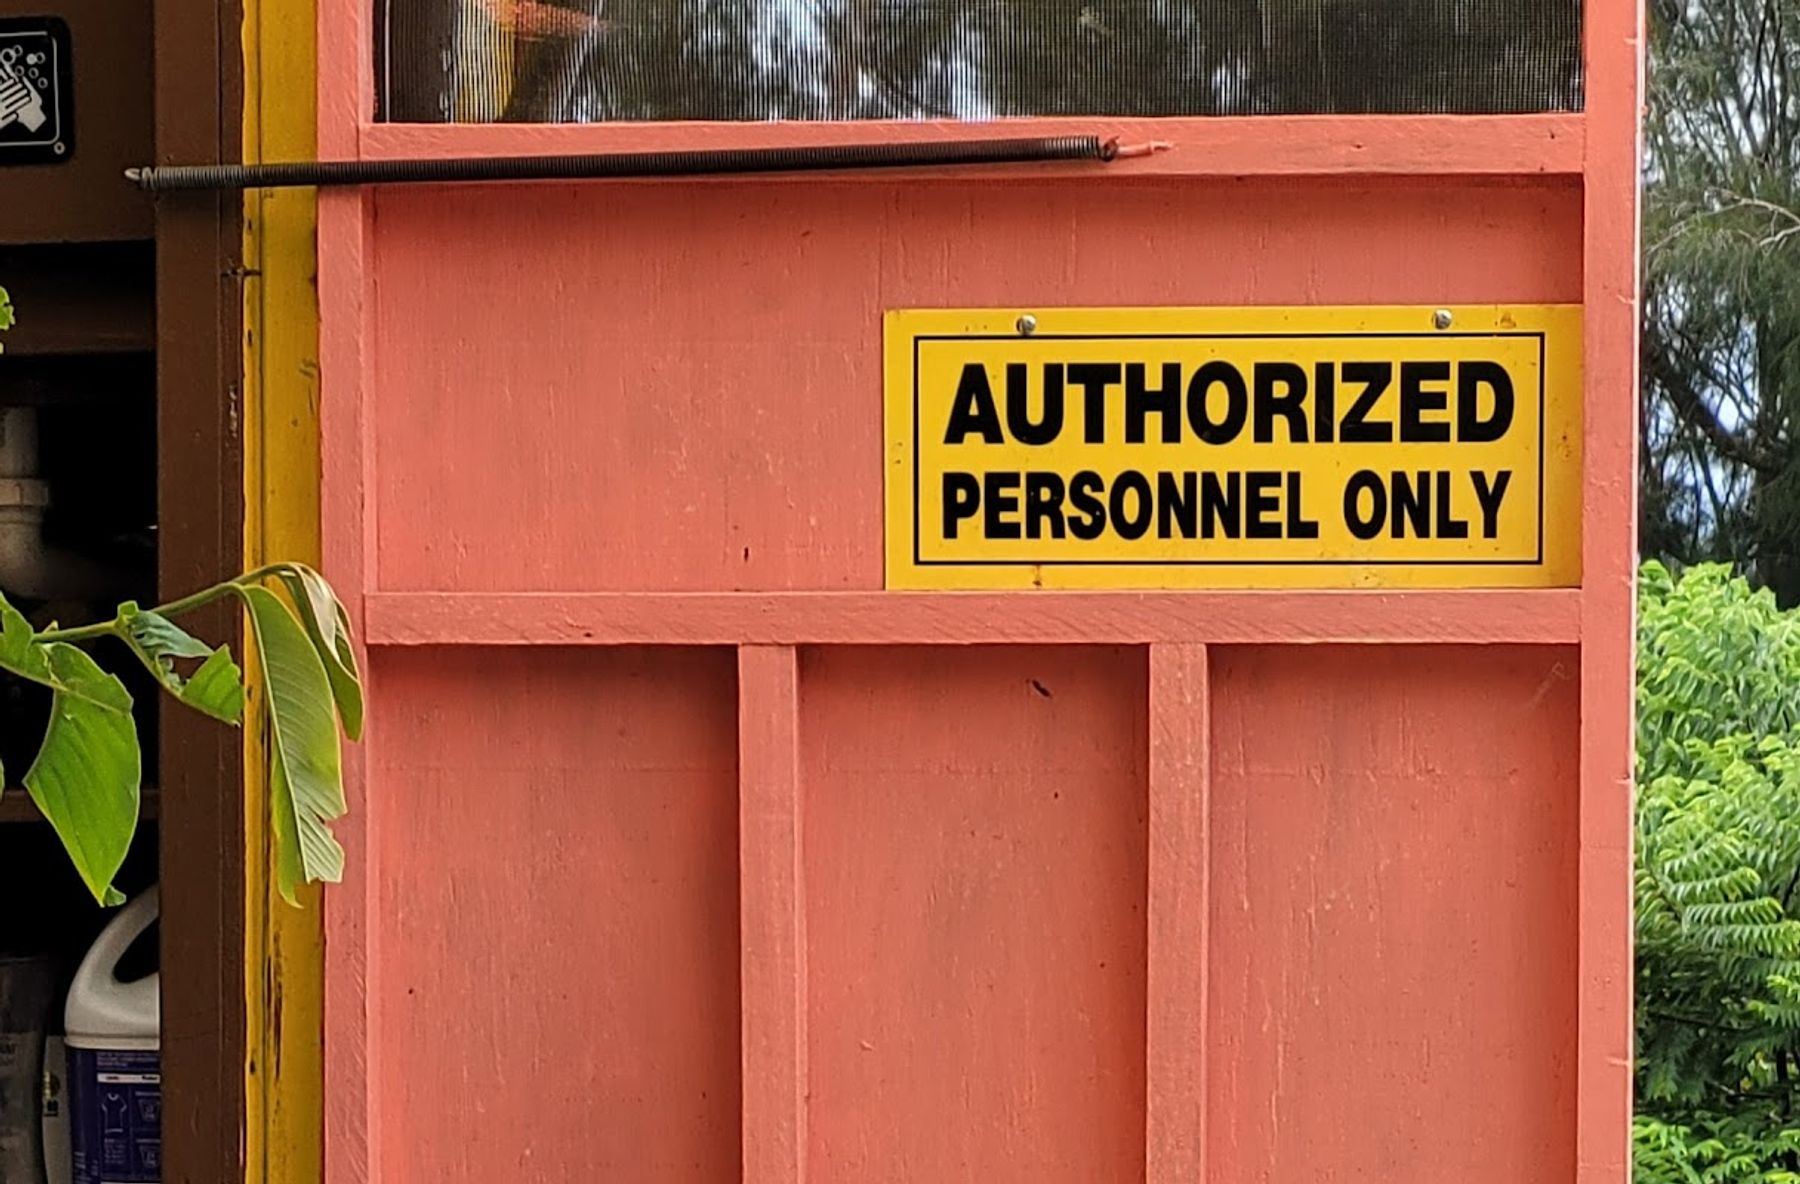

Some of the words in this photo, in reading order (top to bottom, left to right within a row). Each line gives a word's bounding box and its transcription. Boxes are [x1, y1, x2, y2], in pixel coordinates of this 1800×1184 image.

[943, 360, 1515, 445] AUTHORIZED
[942, 469, 1318, 540] PERSONNEL
[1343, 469, 1512, 540] ONLY
